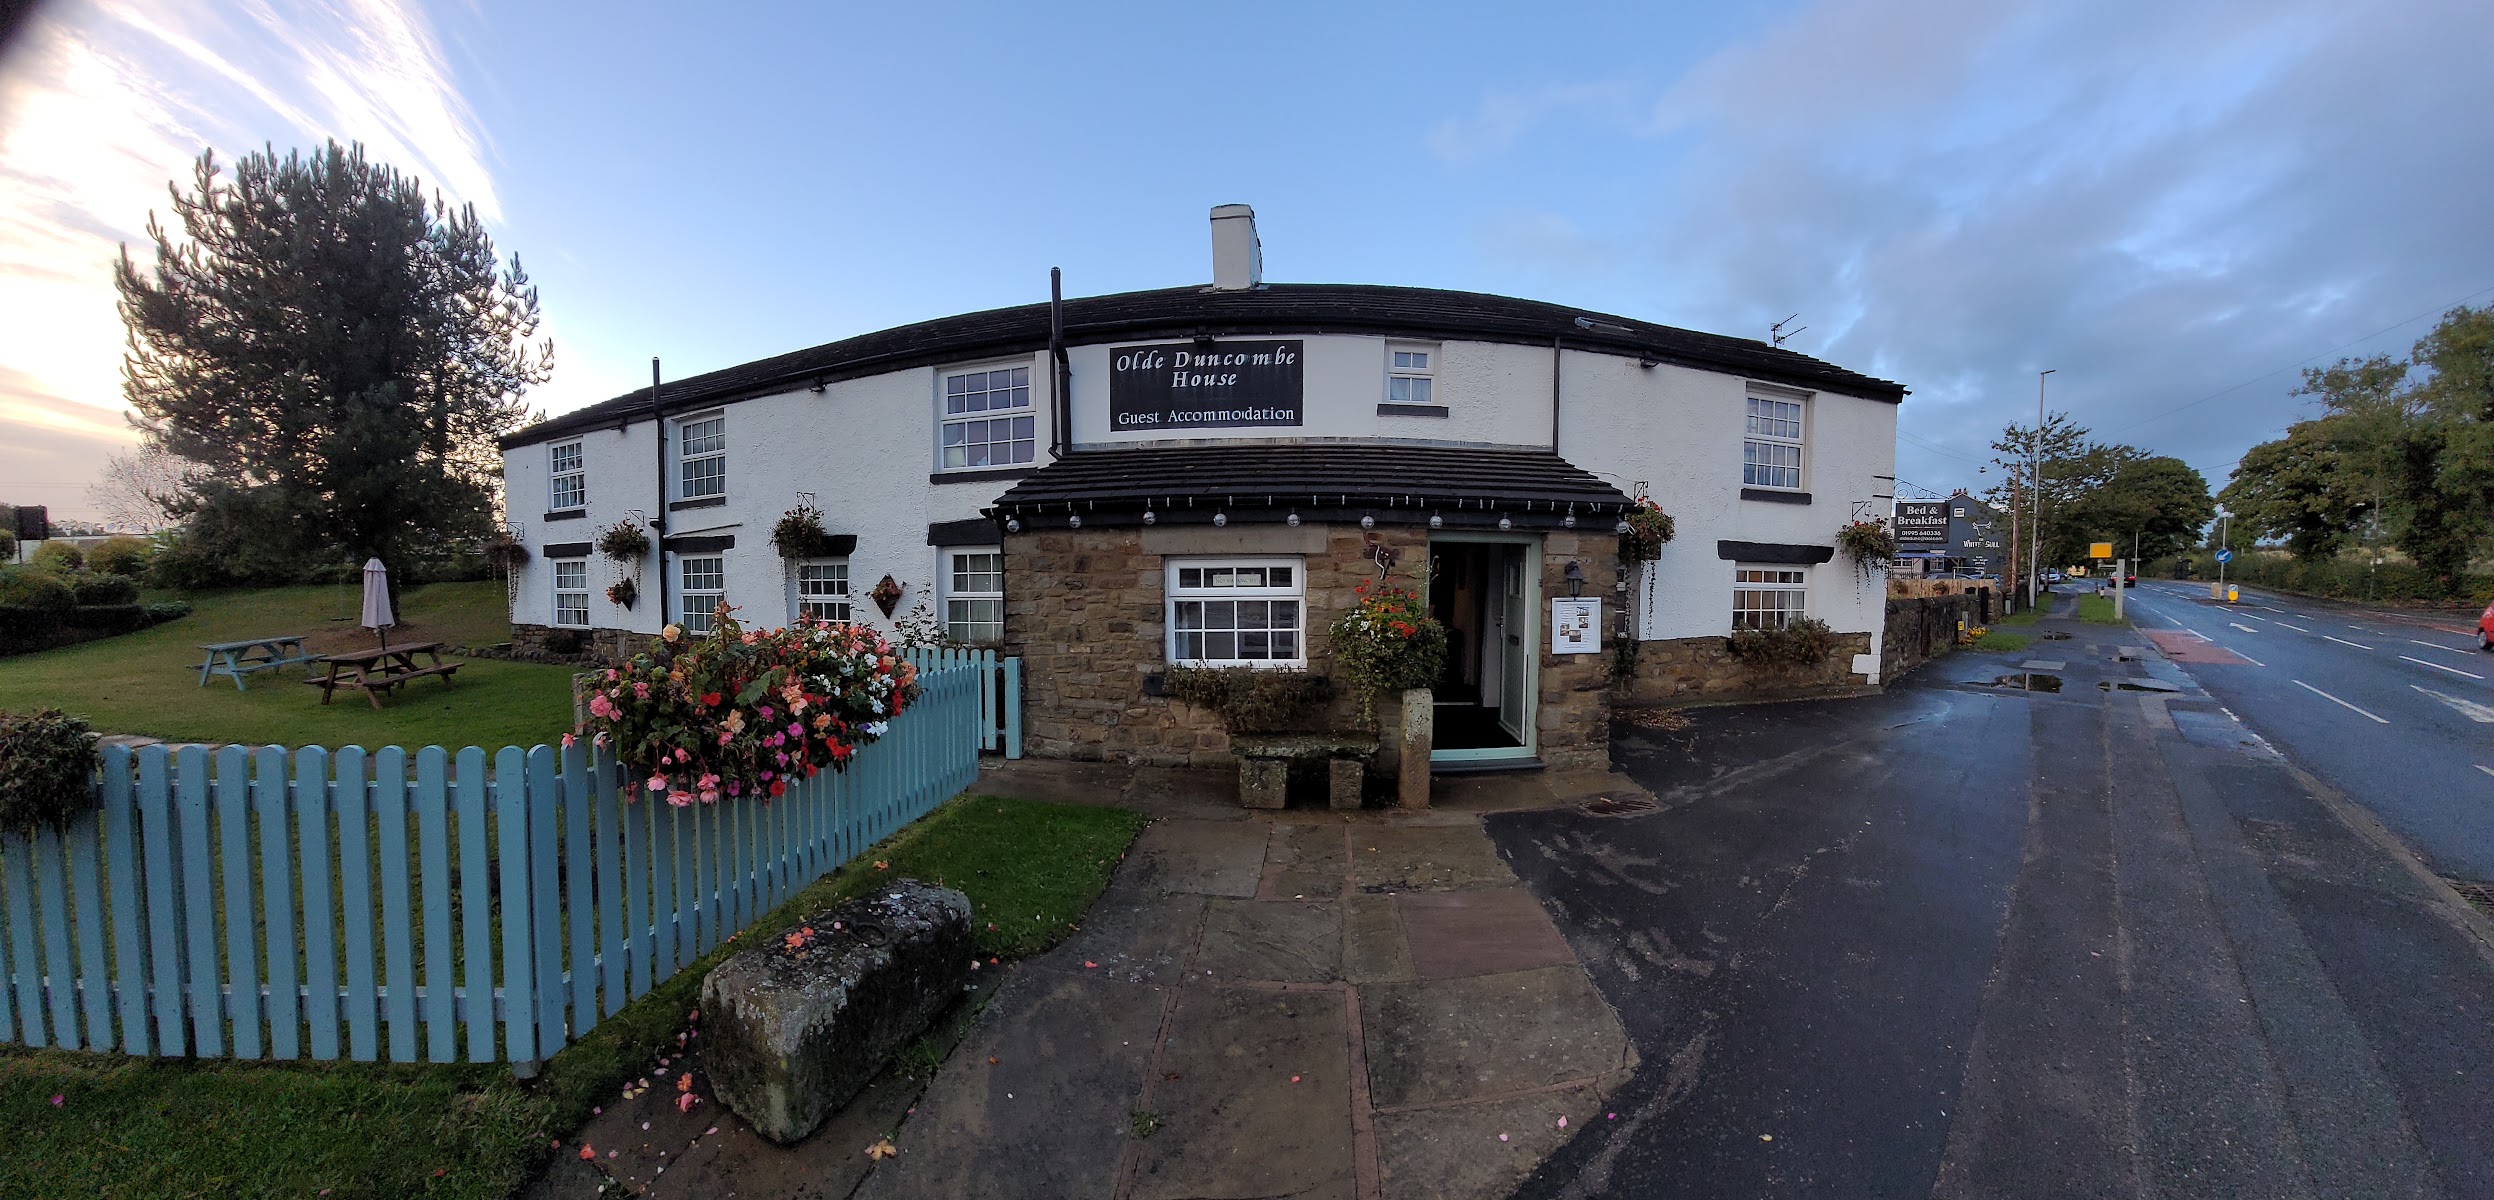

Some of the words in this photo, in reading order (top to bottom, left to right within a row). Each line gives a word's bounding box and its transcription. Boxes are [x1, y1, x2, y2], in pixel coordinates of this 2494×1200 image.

[1116, 350, 1164, 371] Olde
[1173, 346, 1295, 368] Duncombe
[1171, 371, 1237, 388] House
[1118, 411, 1160, 425] Guest
[1167, 406, 1295, 423] Accommodation
[1906, 505, 1927, 515] Bed
[1929, 506, 1938, 515] &
[1897, 516, 1948, 525] Breakfast
